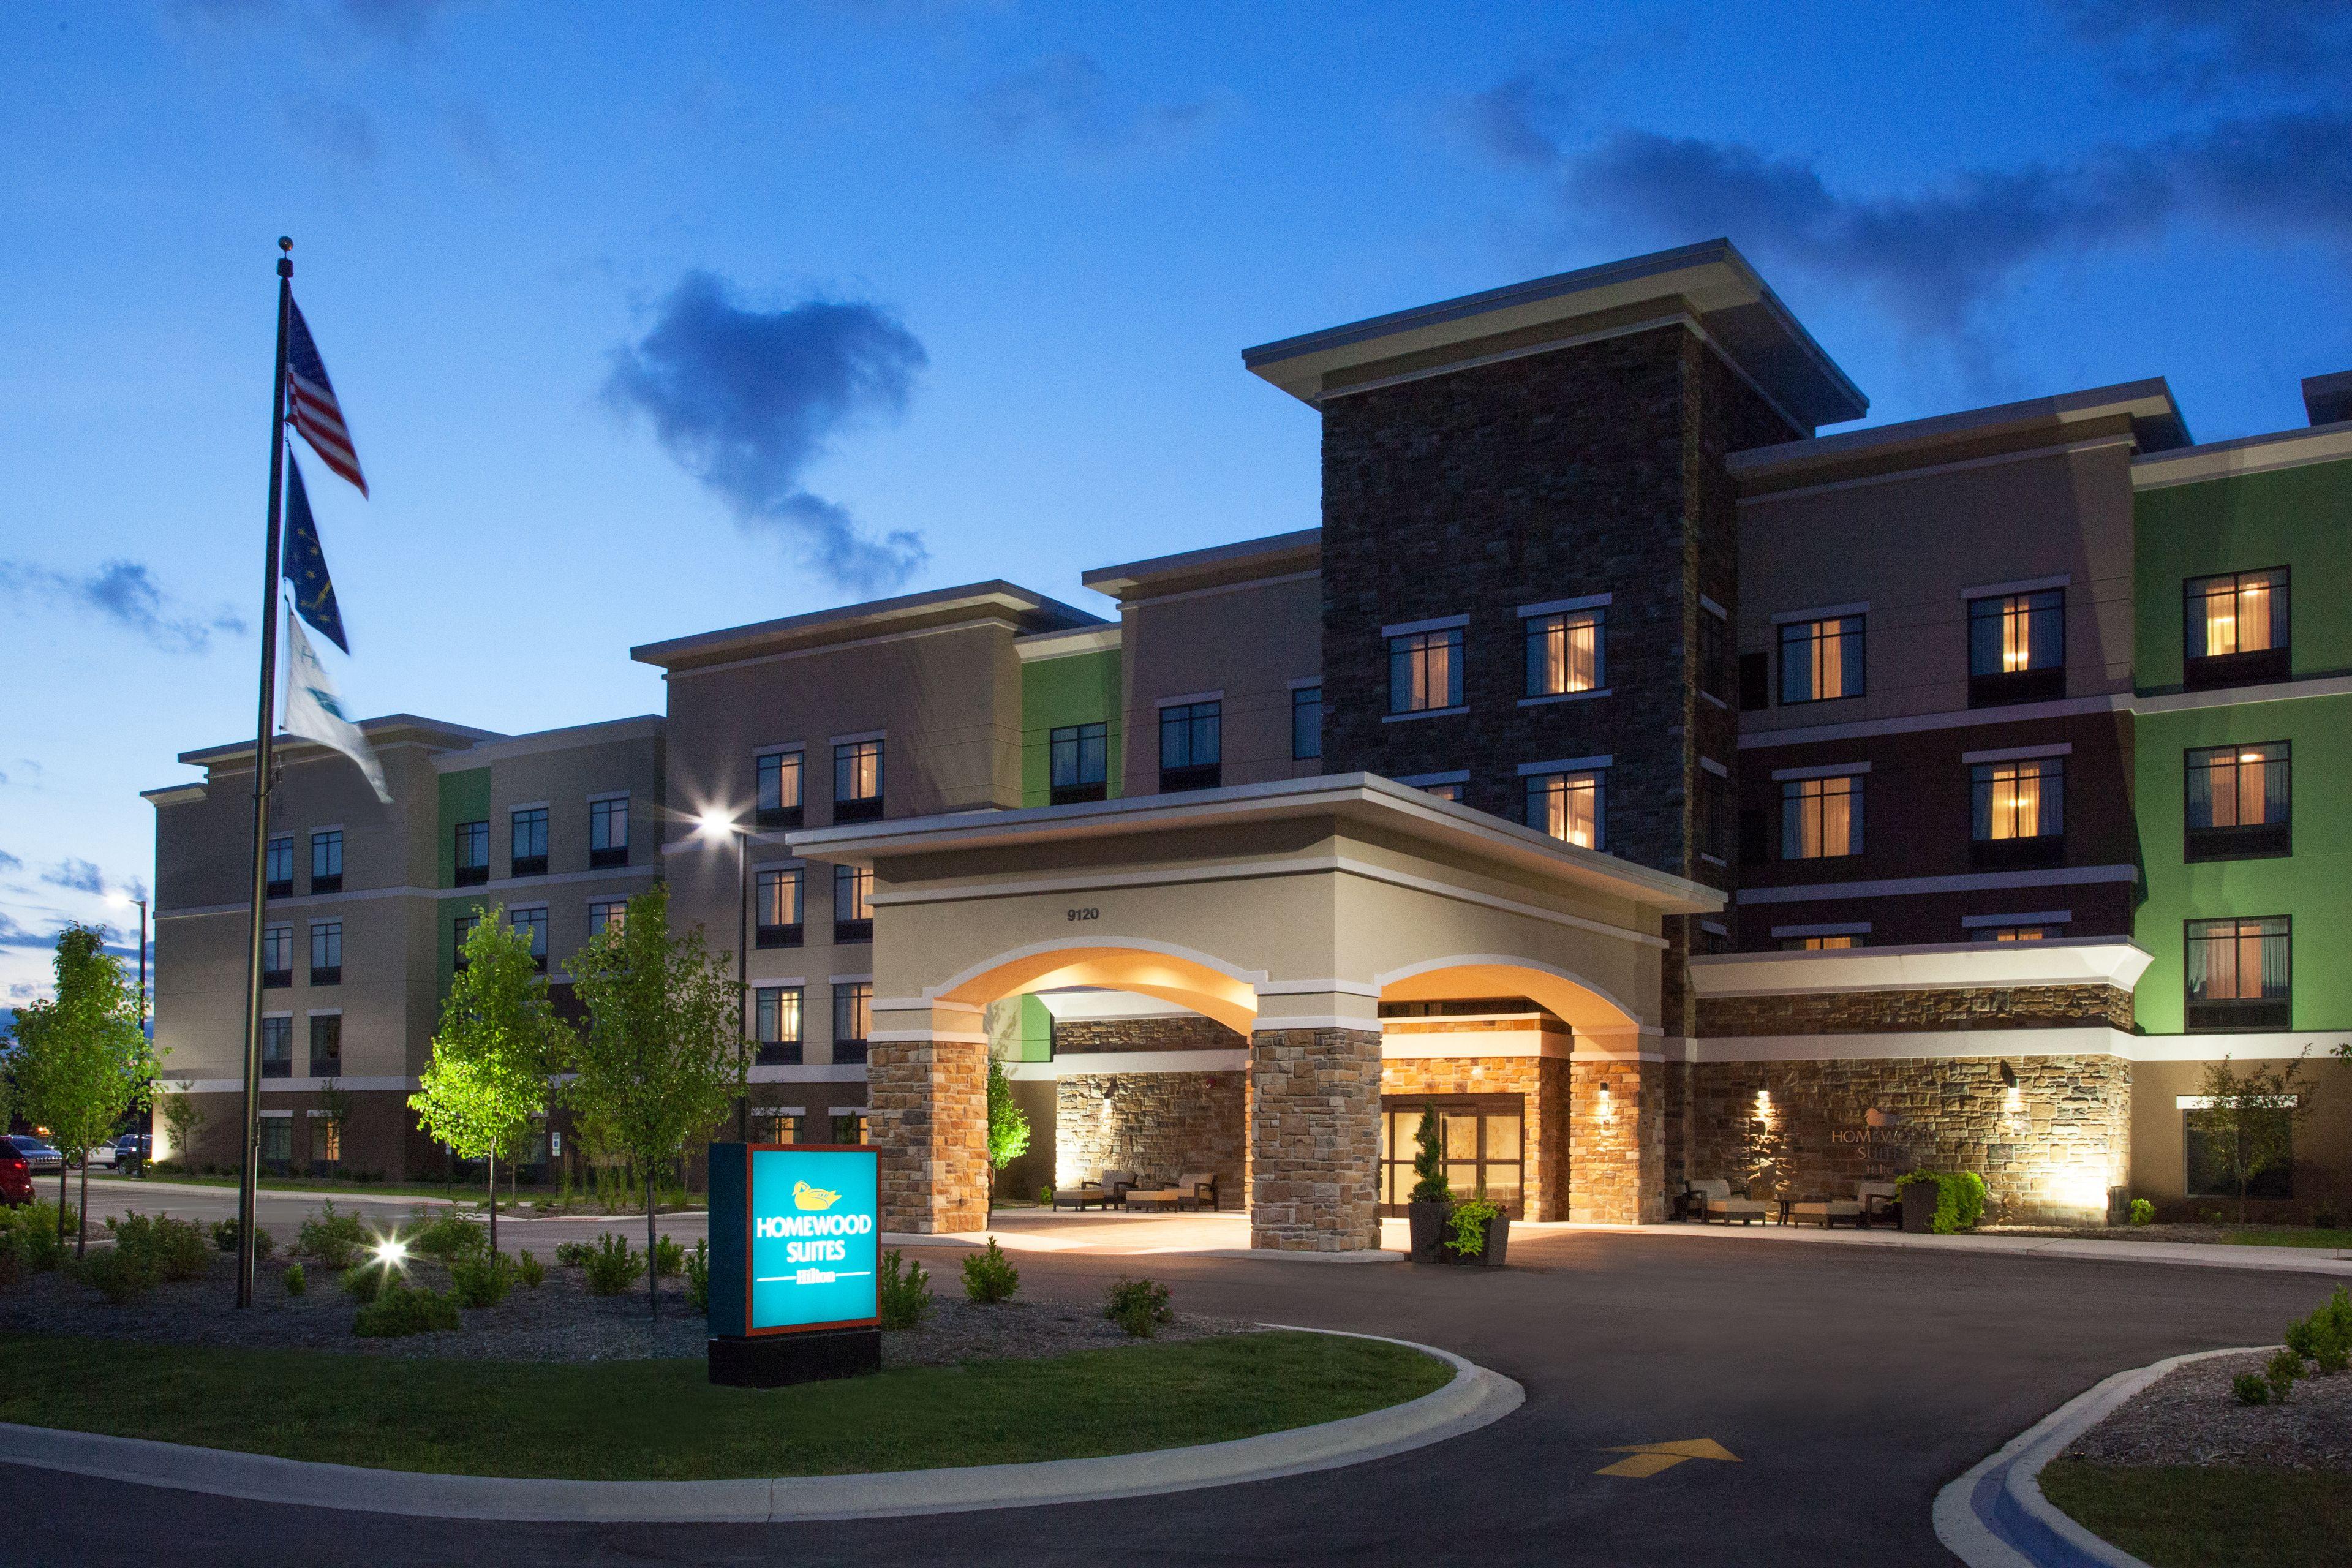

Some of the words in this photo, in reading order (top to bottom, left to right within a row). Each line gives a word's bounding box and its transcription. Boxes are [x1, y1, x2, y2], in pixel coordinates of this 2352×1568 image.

[1067, 907, 1099, 921] 9120
[756, 1214, 872, 1238] HOMEWOOD
[786, 1240, 846, 1263] SUITES
[796, 1267, 836, 1285] Hilton
